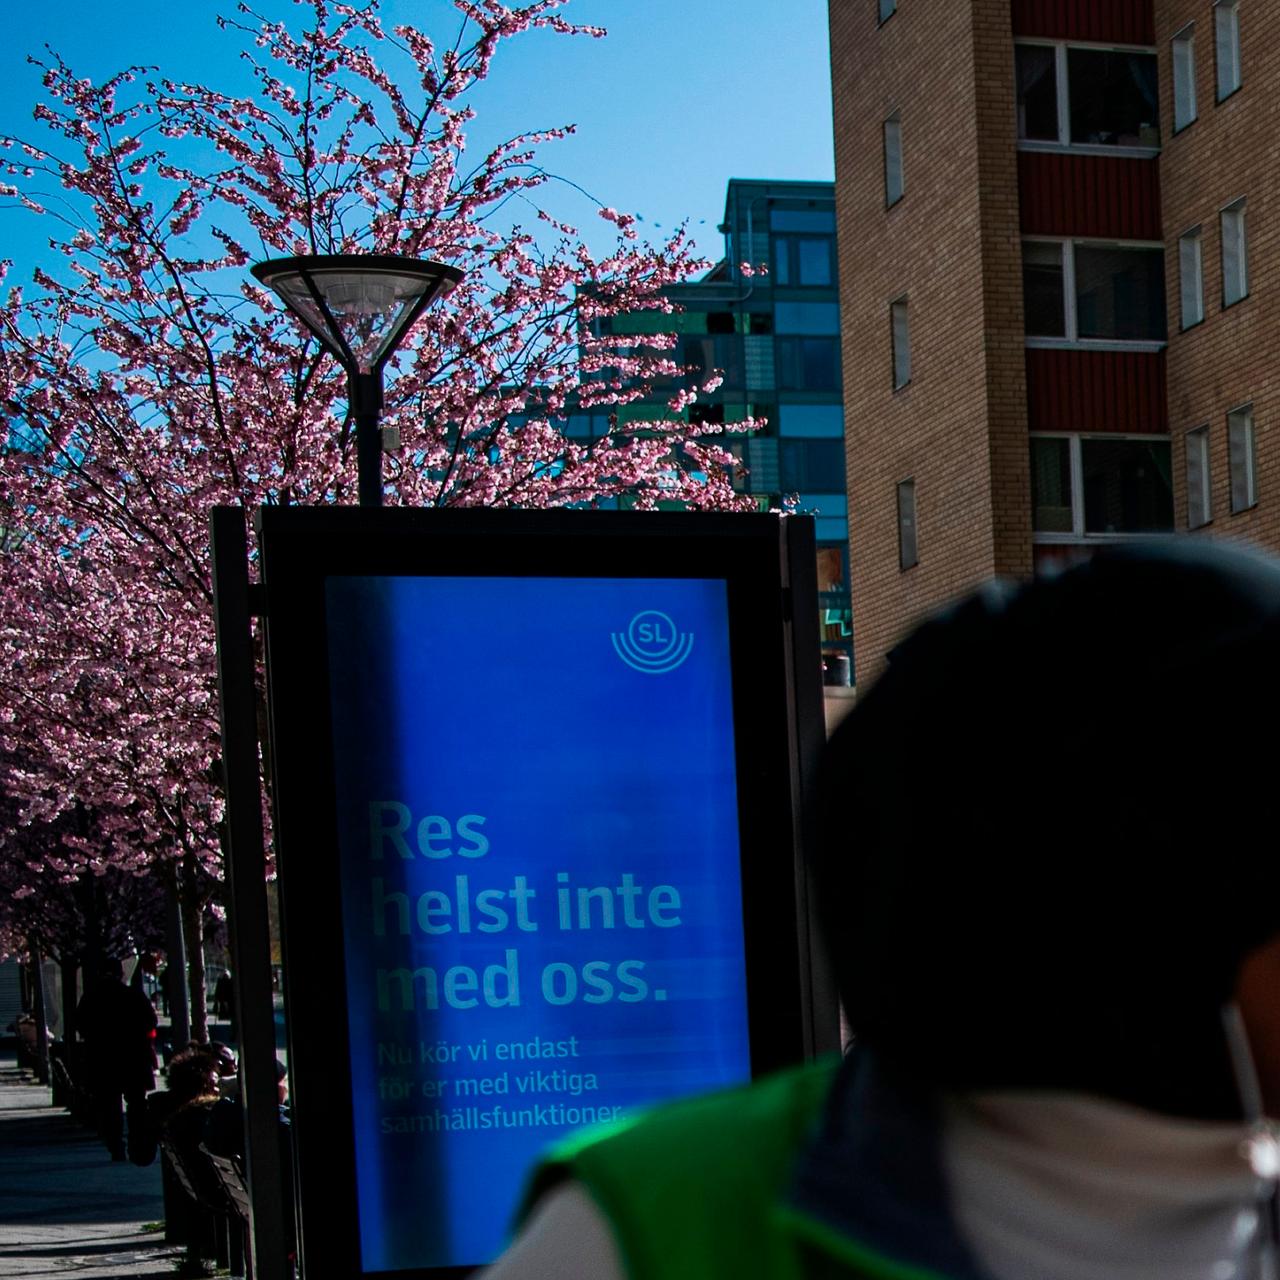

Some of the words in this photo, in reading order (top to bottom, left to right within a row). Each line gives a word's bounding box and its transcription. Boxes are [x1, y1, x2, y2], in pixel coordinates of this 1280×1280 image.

[637, 622, 669, 646] SL
[367, 799, 491, 861] Res
[372, 872, 538, 936] helst
[556, 871, 683, 931] inte
[376, 948, 521, 1012] med
[540, 959, 668, 1007] oss.
[378, 1042, 412, 1064] Nu
[421, 1040, 461, 1063] kör
[468, 1039, 488, 1061] vi
[495, 1036, 580, 1061] endast
[377, 1077, 414, 1099] för
[422, 1080, 449, 1097] er
[455, 1072, 509, 1096] med
[516, 1069, 599, 1096] viktiga
[380, 1102, 627, 1135] samhällsfunktioner.
